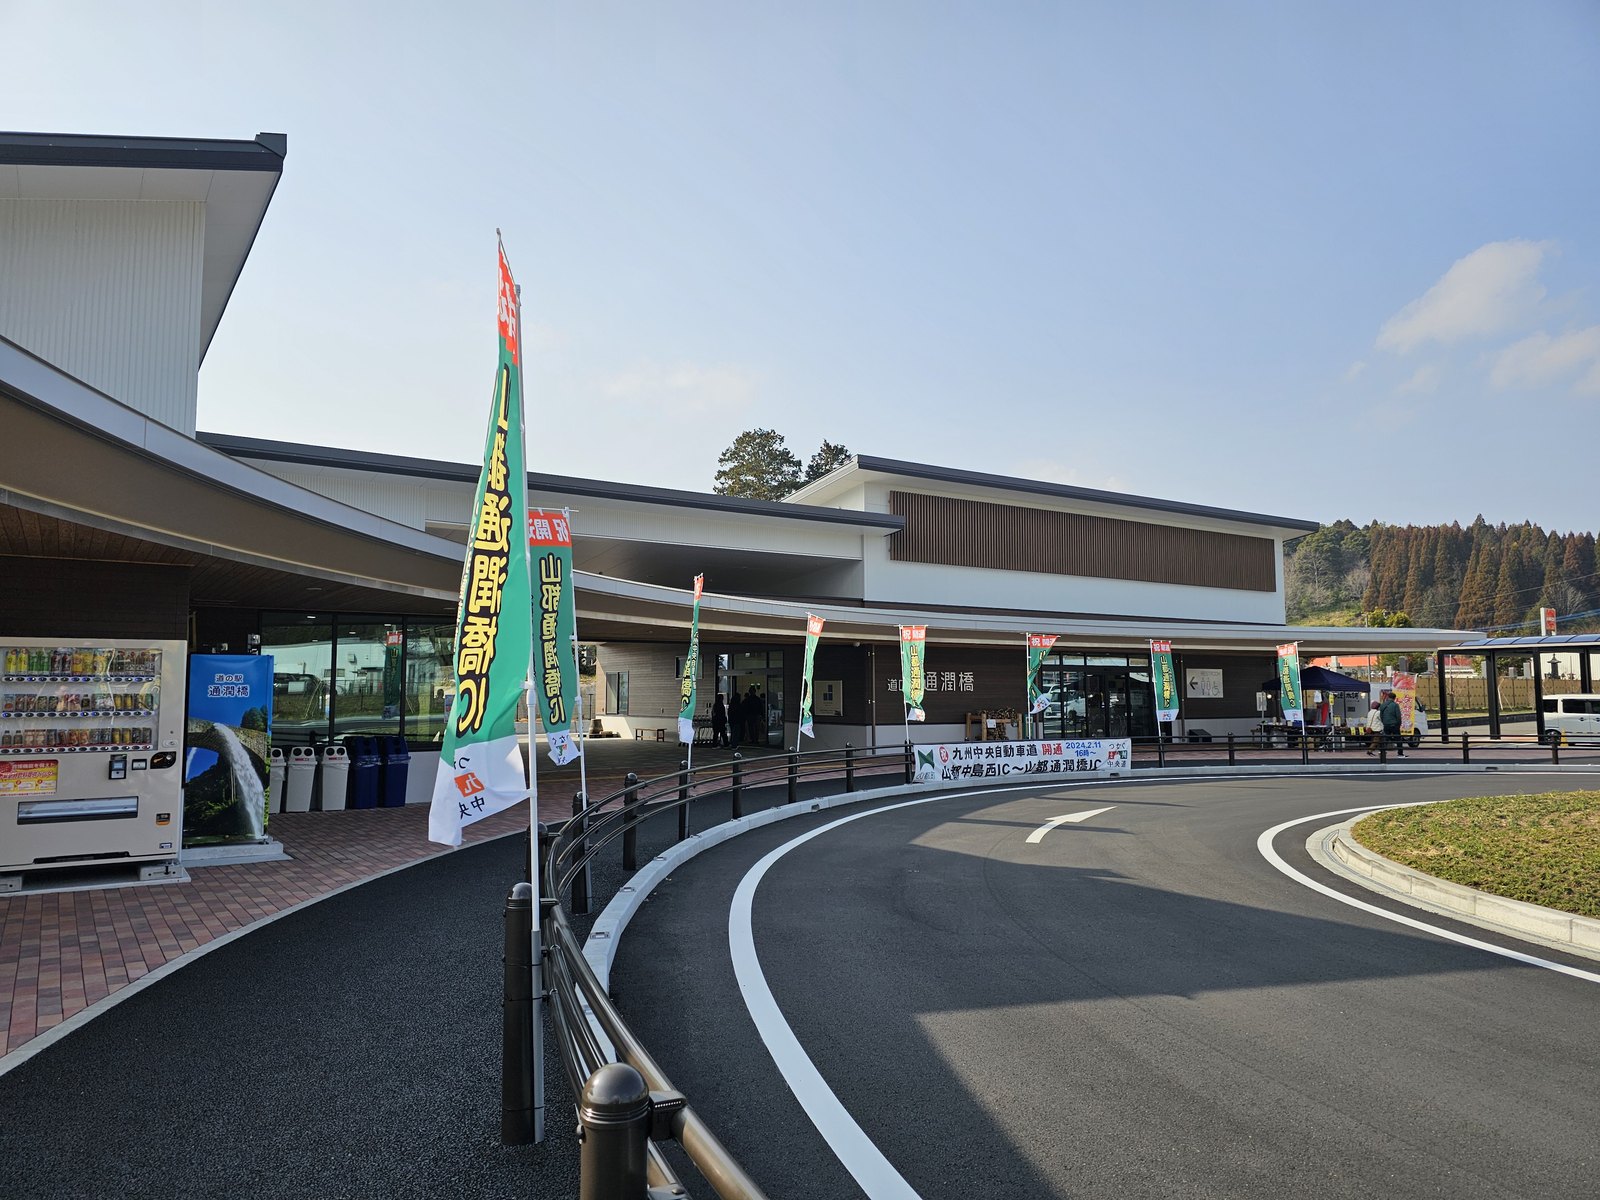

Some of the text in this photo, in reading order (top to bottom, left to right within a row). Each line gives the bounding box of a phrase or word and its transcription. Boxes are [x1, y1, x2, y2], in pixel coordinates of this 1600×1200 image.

[215, 673, 243, 683] 道の駅
[207, 685, 249, 697] 通潤橋
[952, 743, 1038, 760] 九州中央自動車道
[1041, 743, 1063, 756] 開通
[1065, 741, 1101, 750] 2024.2.11
